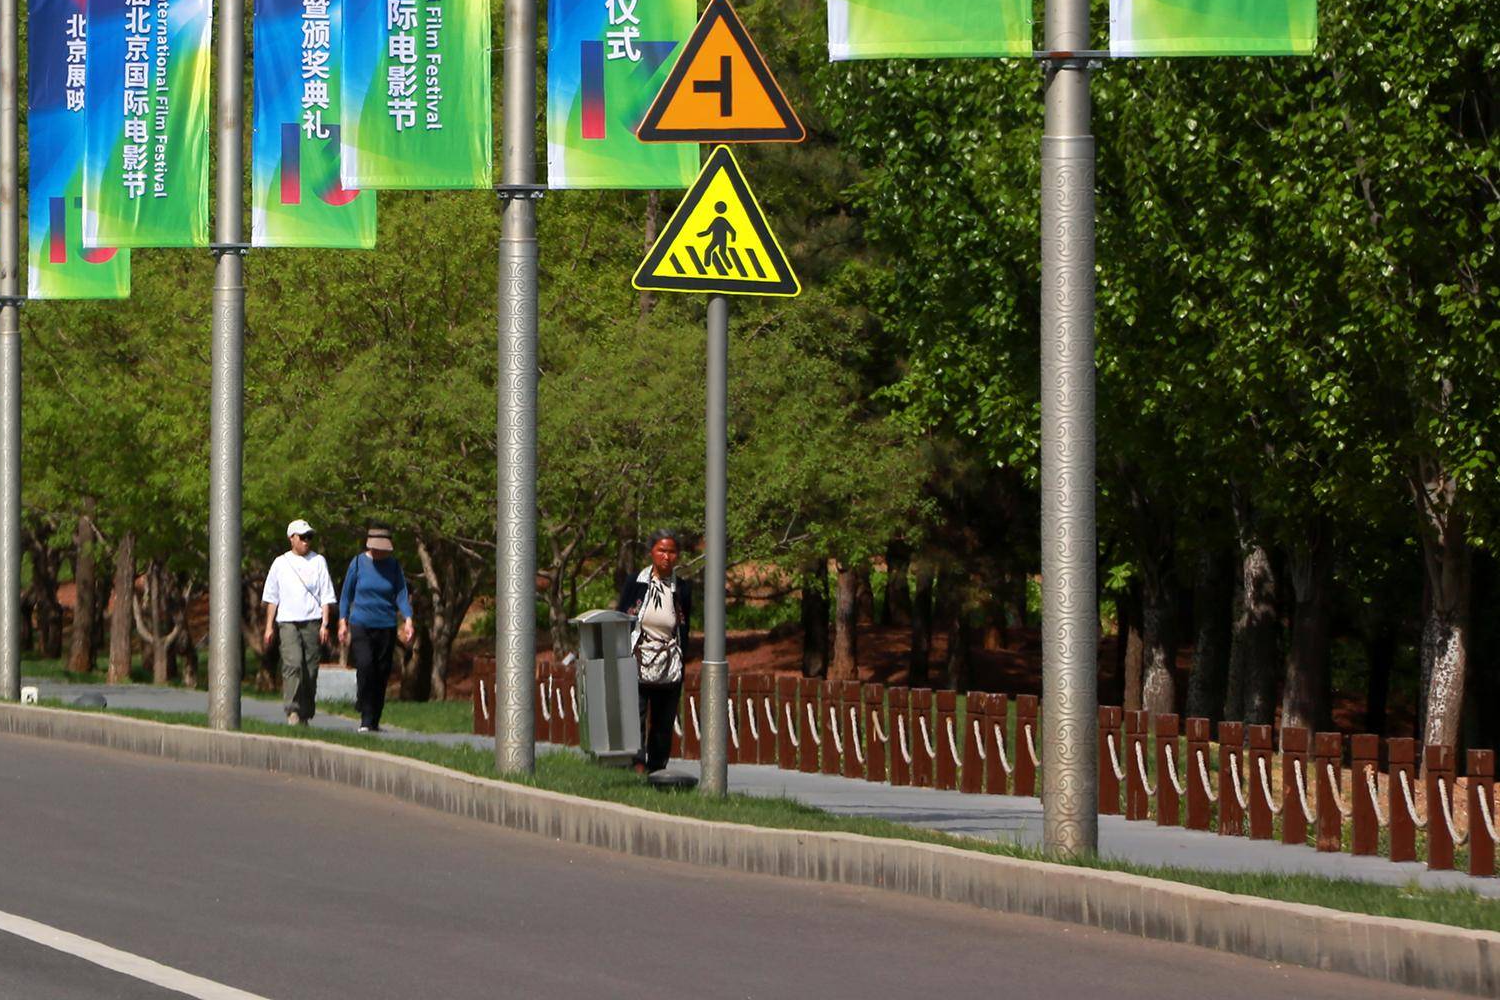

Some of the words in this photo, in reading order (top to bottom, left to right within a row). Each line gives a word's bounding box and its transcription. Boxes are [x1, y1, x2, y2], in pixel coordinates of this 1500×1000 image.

[426, 6, 442, 49] Film
[155, 96, 170, 131] Film
[426, 53, 442, 130] Festival
[154, 134, 169, 199] Festival
